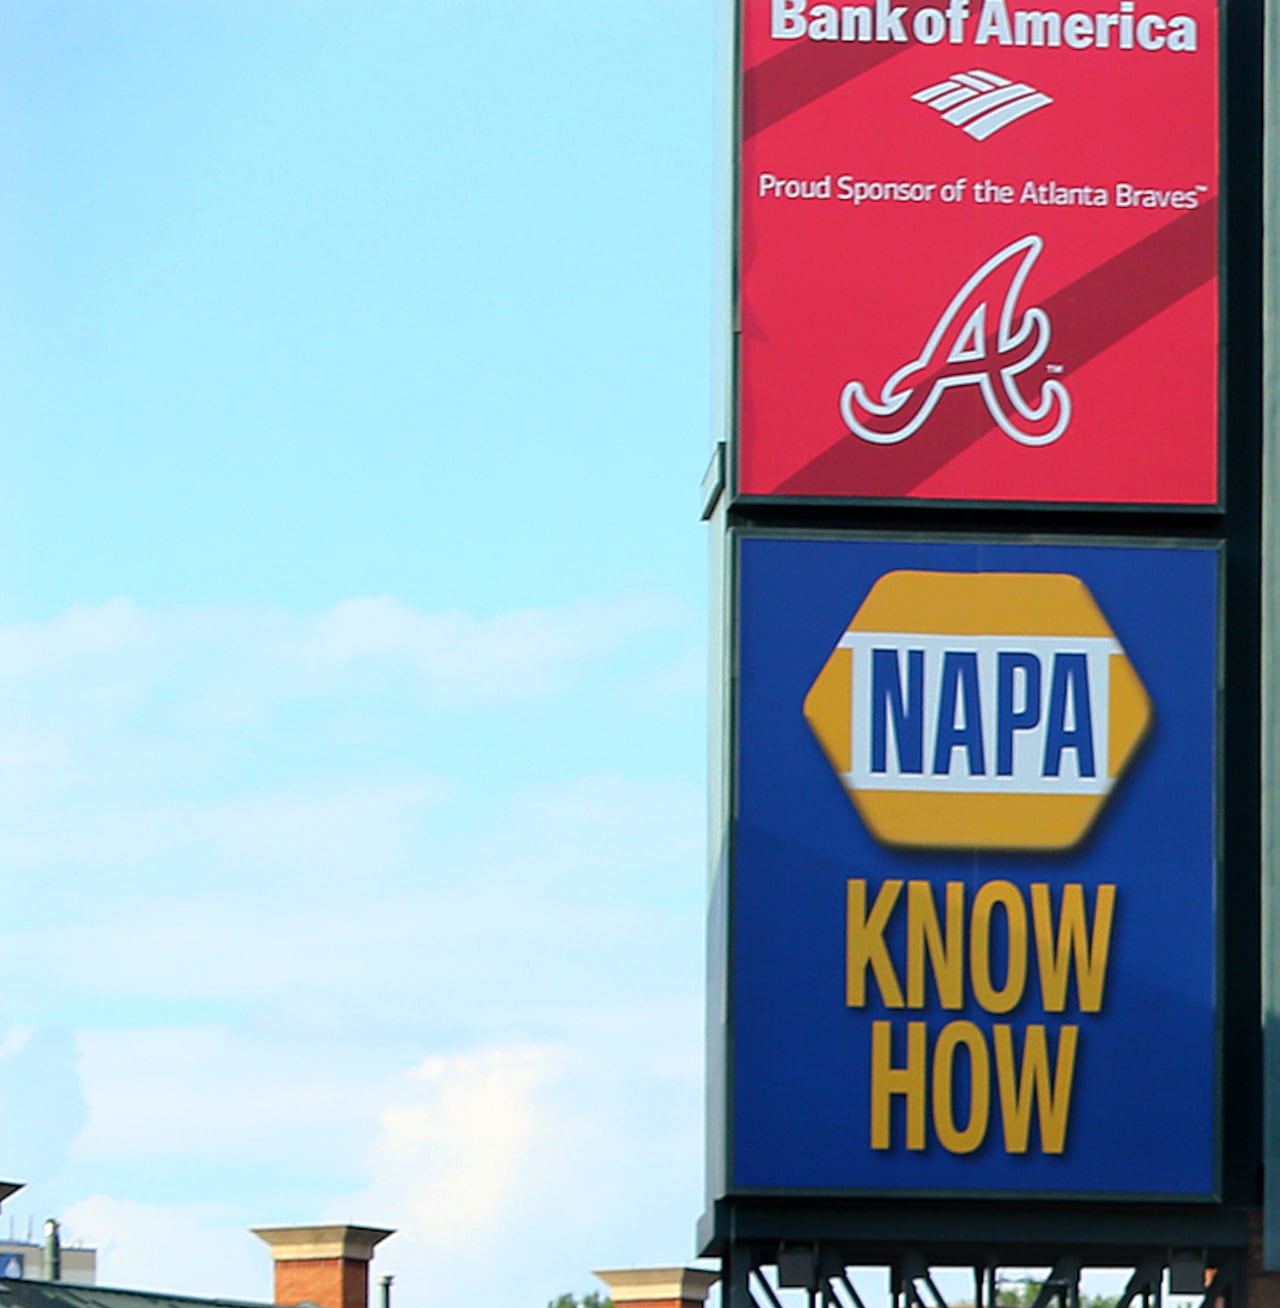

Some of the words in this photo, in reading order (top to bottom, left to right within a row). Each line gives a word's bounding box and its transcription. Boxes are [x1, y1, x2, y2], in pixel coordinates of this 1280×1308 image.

[770, 0, 908, 42] Bank
[912, 0, 970, 44] of
[974, 0, 1198, 52] America
[758, 174, 831, 199] Proud
[836, 176, 934, 205] Sponsor
[940, 177, 964, 202] of
[974, 178, 1014, 203] the
[1020, 181, 1108, 206] Atlanta
[840, 234, 1072, 447] A
[870, 647, 1097, 779] NAPA
[846, 878, 1118, 1014] KNOW
[870, 1020, 1079, 1155] HOW
